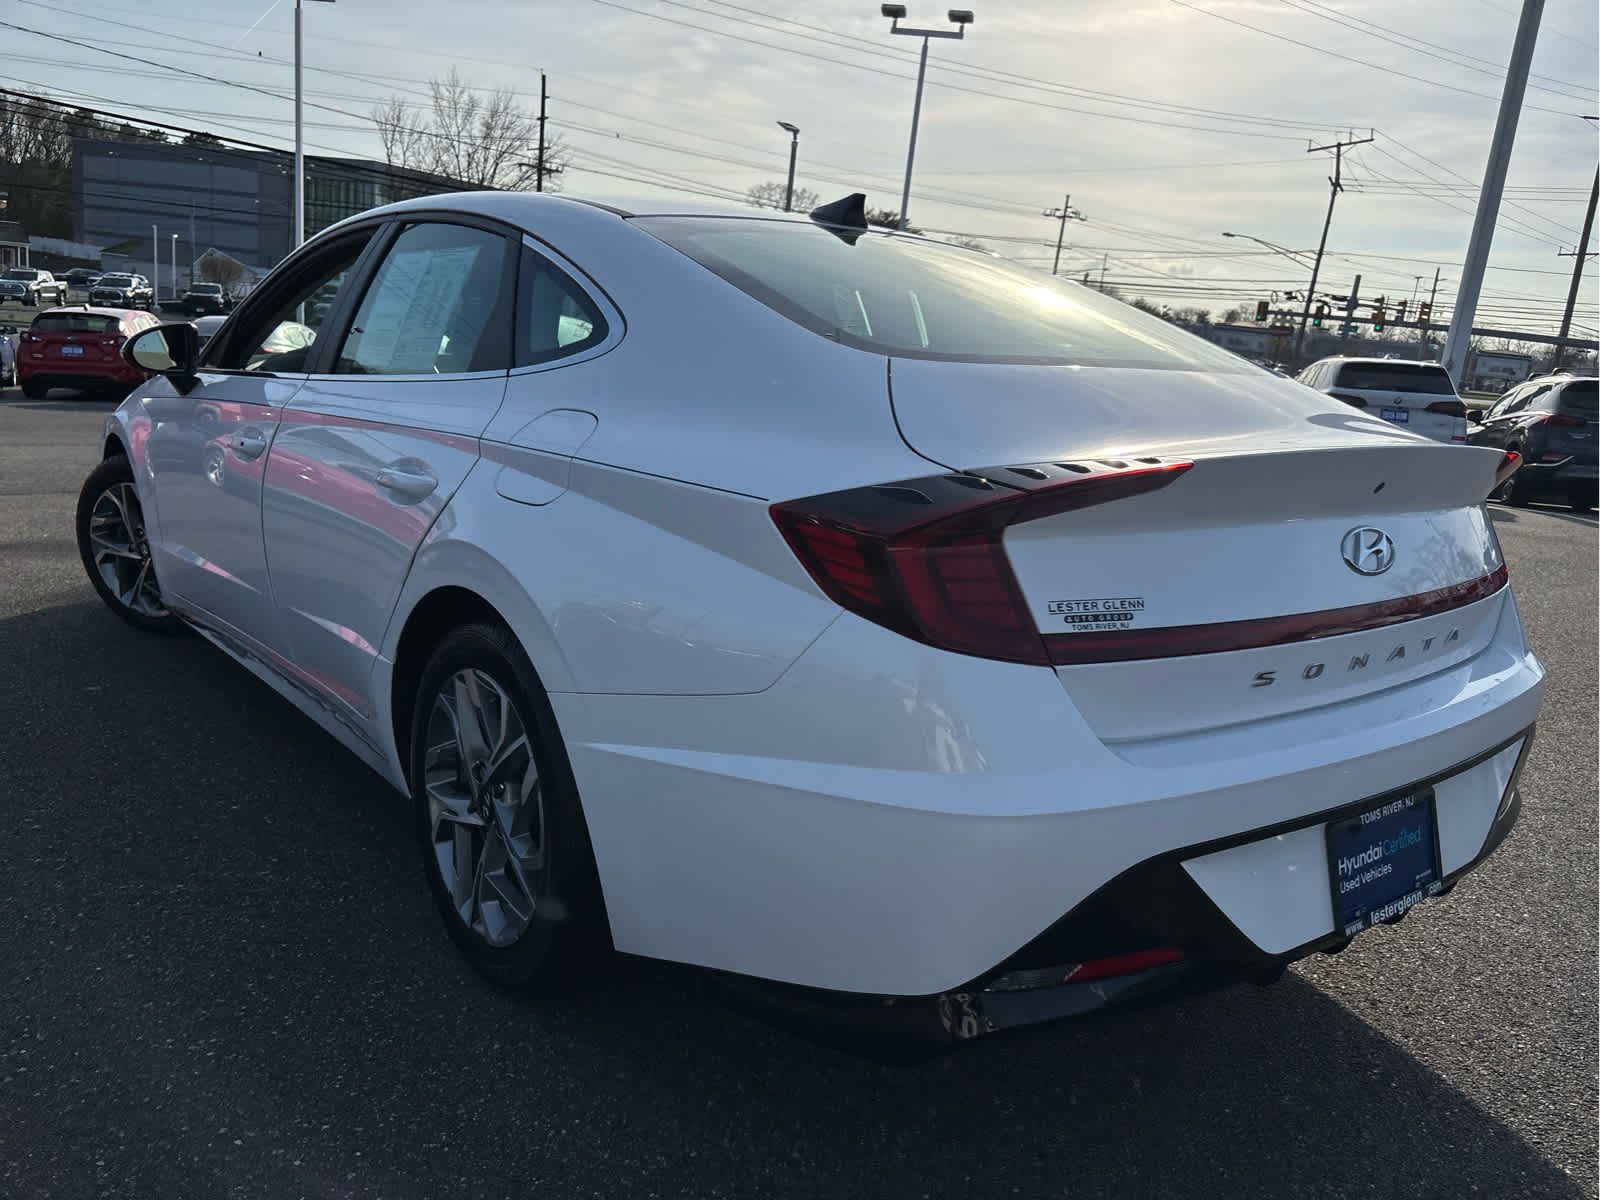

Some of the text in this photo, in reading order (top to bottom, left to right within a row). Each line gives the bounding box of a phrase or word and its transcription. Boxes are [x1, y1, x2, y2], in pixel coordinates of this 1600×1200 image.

[1048, 600, 1144, 613] LESTER GLENN
[1098, 613, 1132, 621] GROUP
[1072, 623, 1093, 631] TOMS
[1251, 628, 1460, 688] SONATA
[1360, 808, 1381, 825] TOMS
[1405, 795, 1415, 809] NJ
[1340, 874, 1360, 894] Used
[1360, 863, 1393, 884] Vehicles
[1370, 891, 1423, 925] lesterglenn
